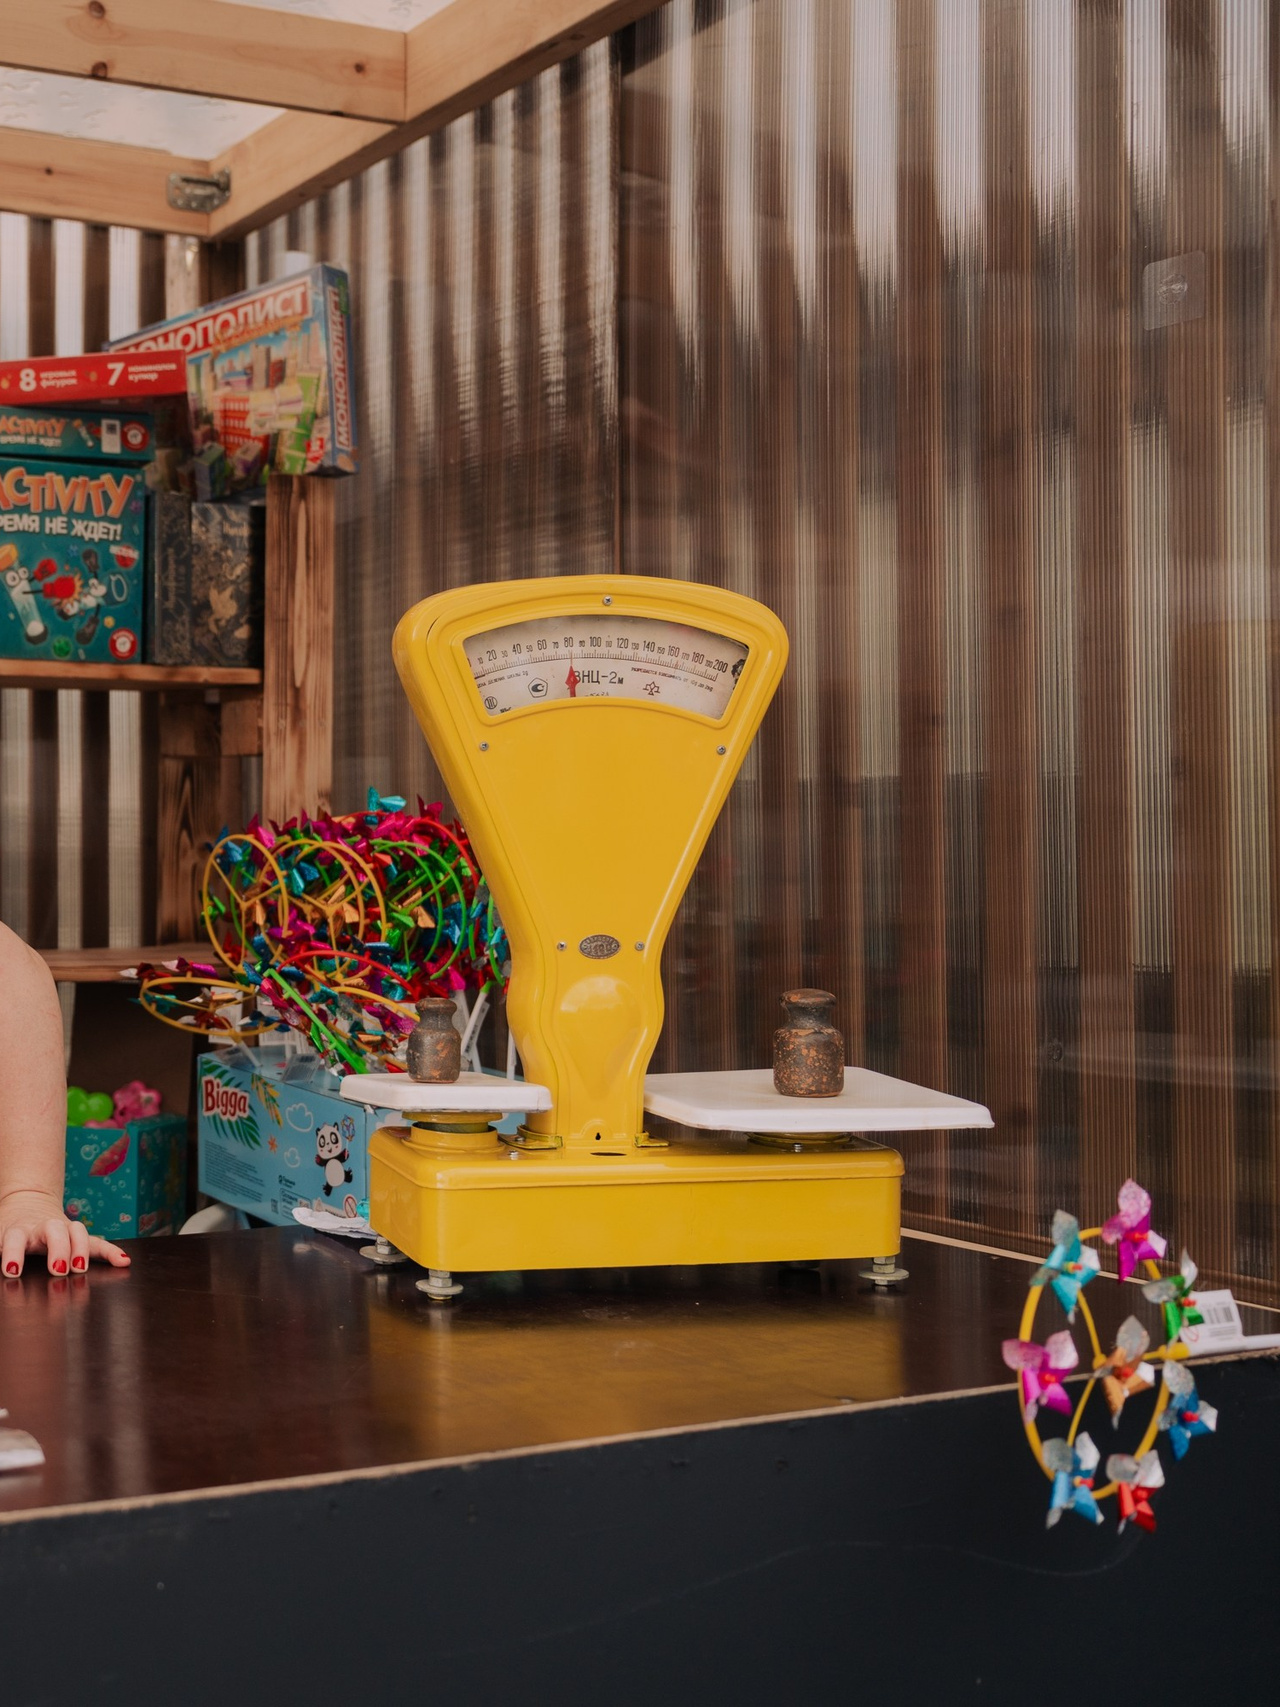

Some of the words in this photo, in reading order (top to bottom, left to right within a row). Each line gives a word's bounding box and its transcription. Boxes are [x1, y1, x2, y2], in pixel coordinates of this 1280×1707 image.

[114, 286, 308, 353] НОПОЛИСТ
[19, 368, 37, 391] 8
[107, 362, 125, 386] 7
[45, 516, 68, 535] НЕ
[71, 519, 123, 542] ЖДЕТ!
[486, 649, 497, 661] 20
[512, 643, 522, 654] 40
[526, 644, 533, 653] 50
[537, 639, 547, 651] 60
[564, 637, 574, 647] 80
[589, 636, 602, 647] 100
[617, 638, 629, 649] 120
[643, 640, 655, 653] 140
[657, 646, 666, 655] 150
[668, 645, 680, 658] 160
[692, 651, 705, 665] 180
[713, 659, 729, 673] 200
[203, 1078, 249, 1118] Bigga
